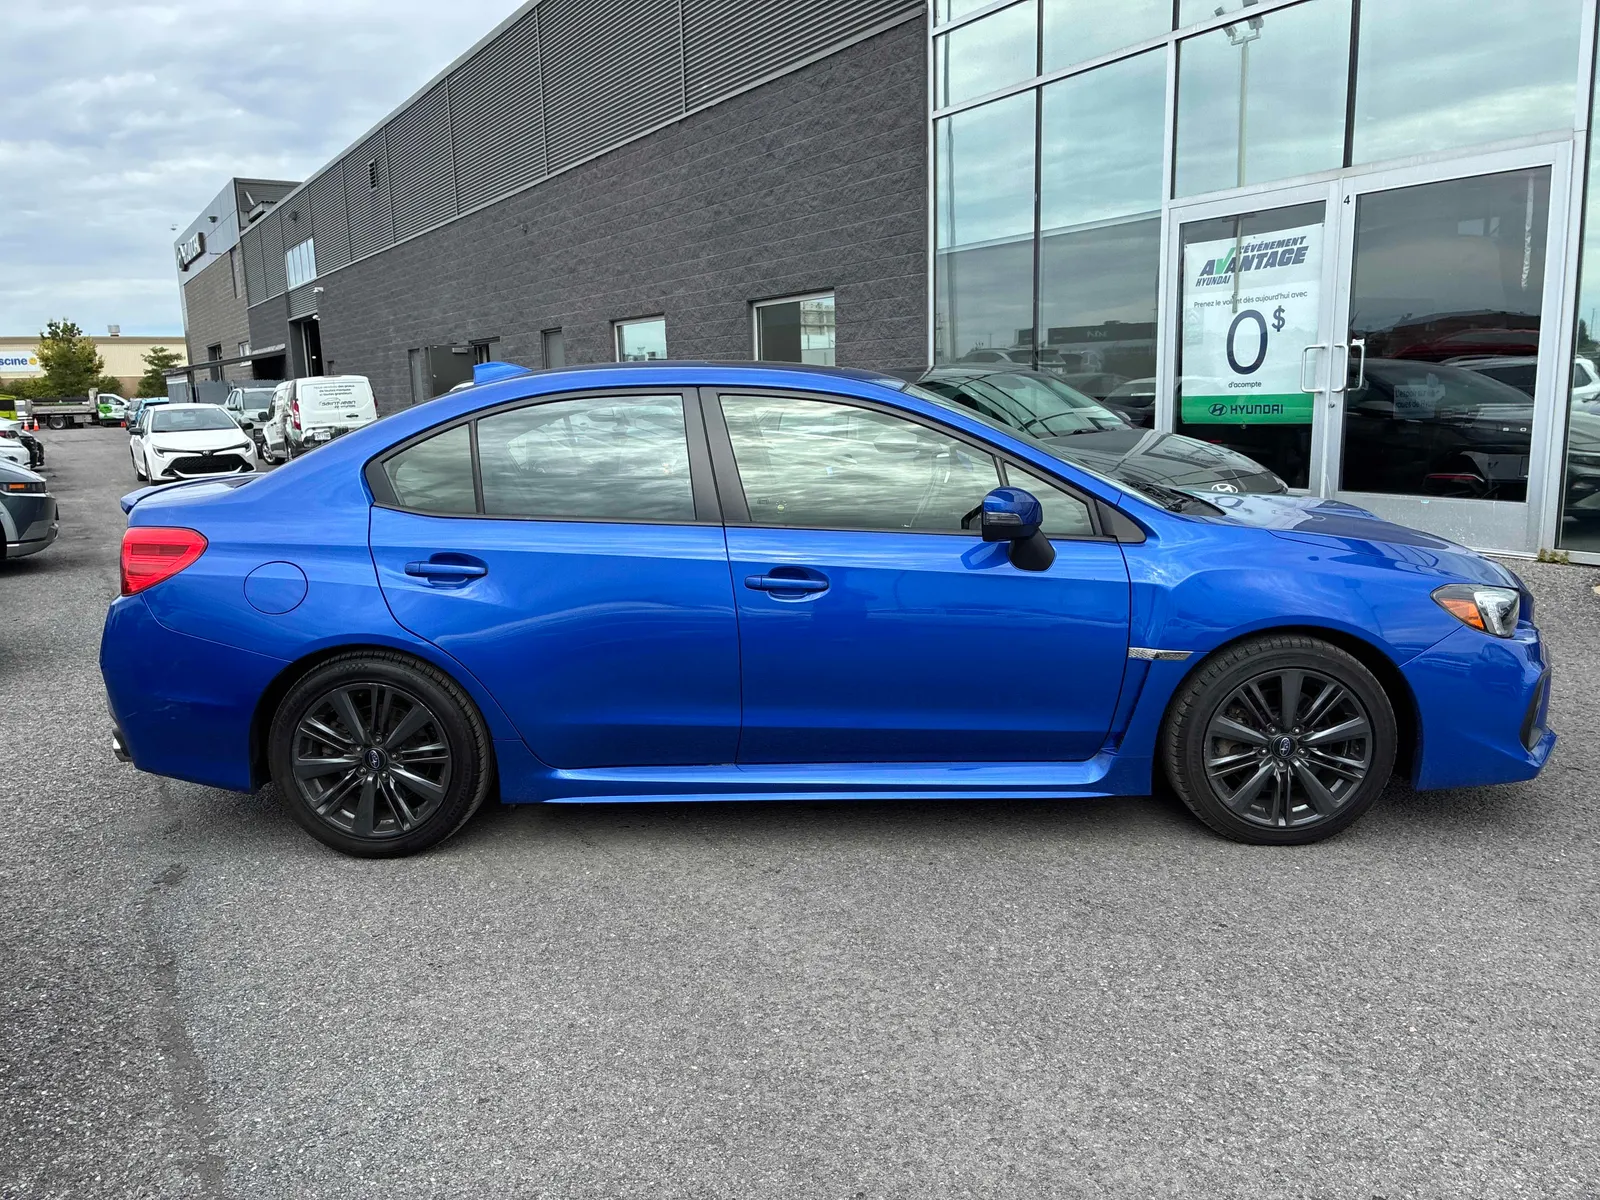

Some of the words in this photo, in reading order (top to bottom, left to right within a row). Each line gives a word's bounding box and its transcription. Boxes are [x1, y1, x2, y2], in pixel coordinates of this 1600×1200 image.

[1343, 194, 1351, 205] 4
[1199, 245, 1310, 277] AVANTAGE
[1195, 274, 1232, 287] HYUNDAI
[1222, 298, 1242, 306] volnt
[1255, 292, 1290, 304] aujourd'hui
[1290, 291, 1308, 299] avec
[1228, 381, 1262, 389] d'acompte
[1230, 404, 1284, 414] HYUNDAI
